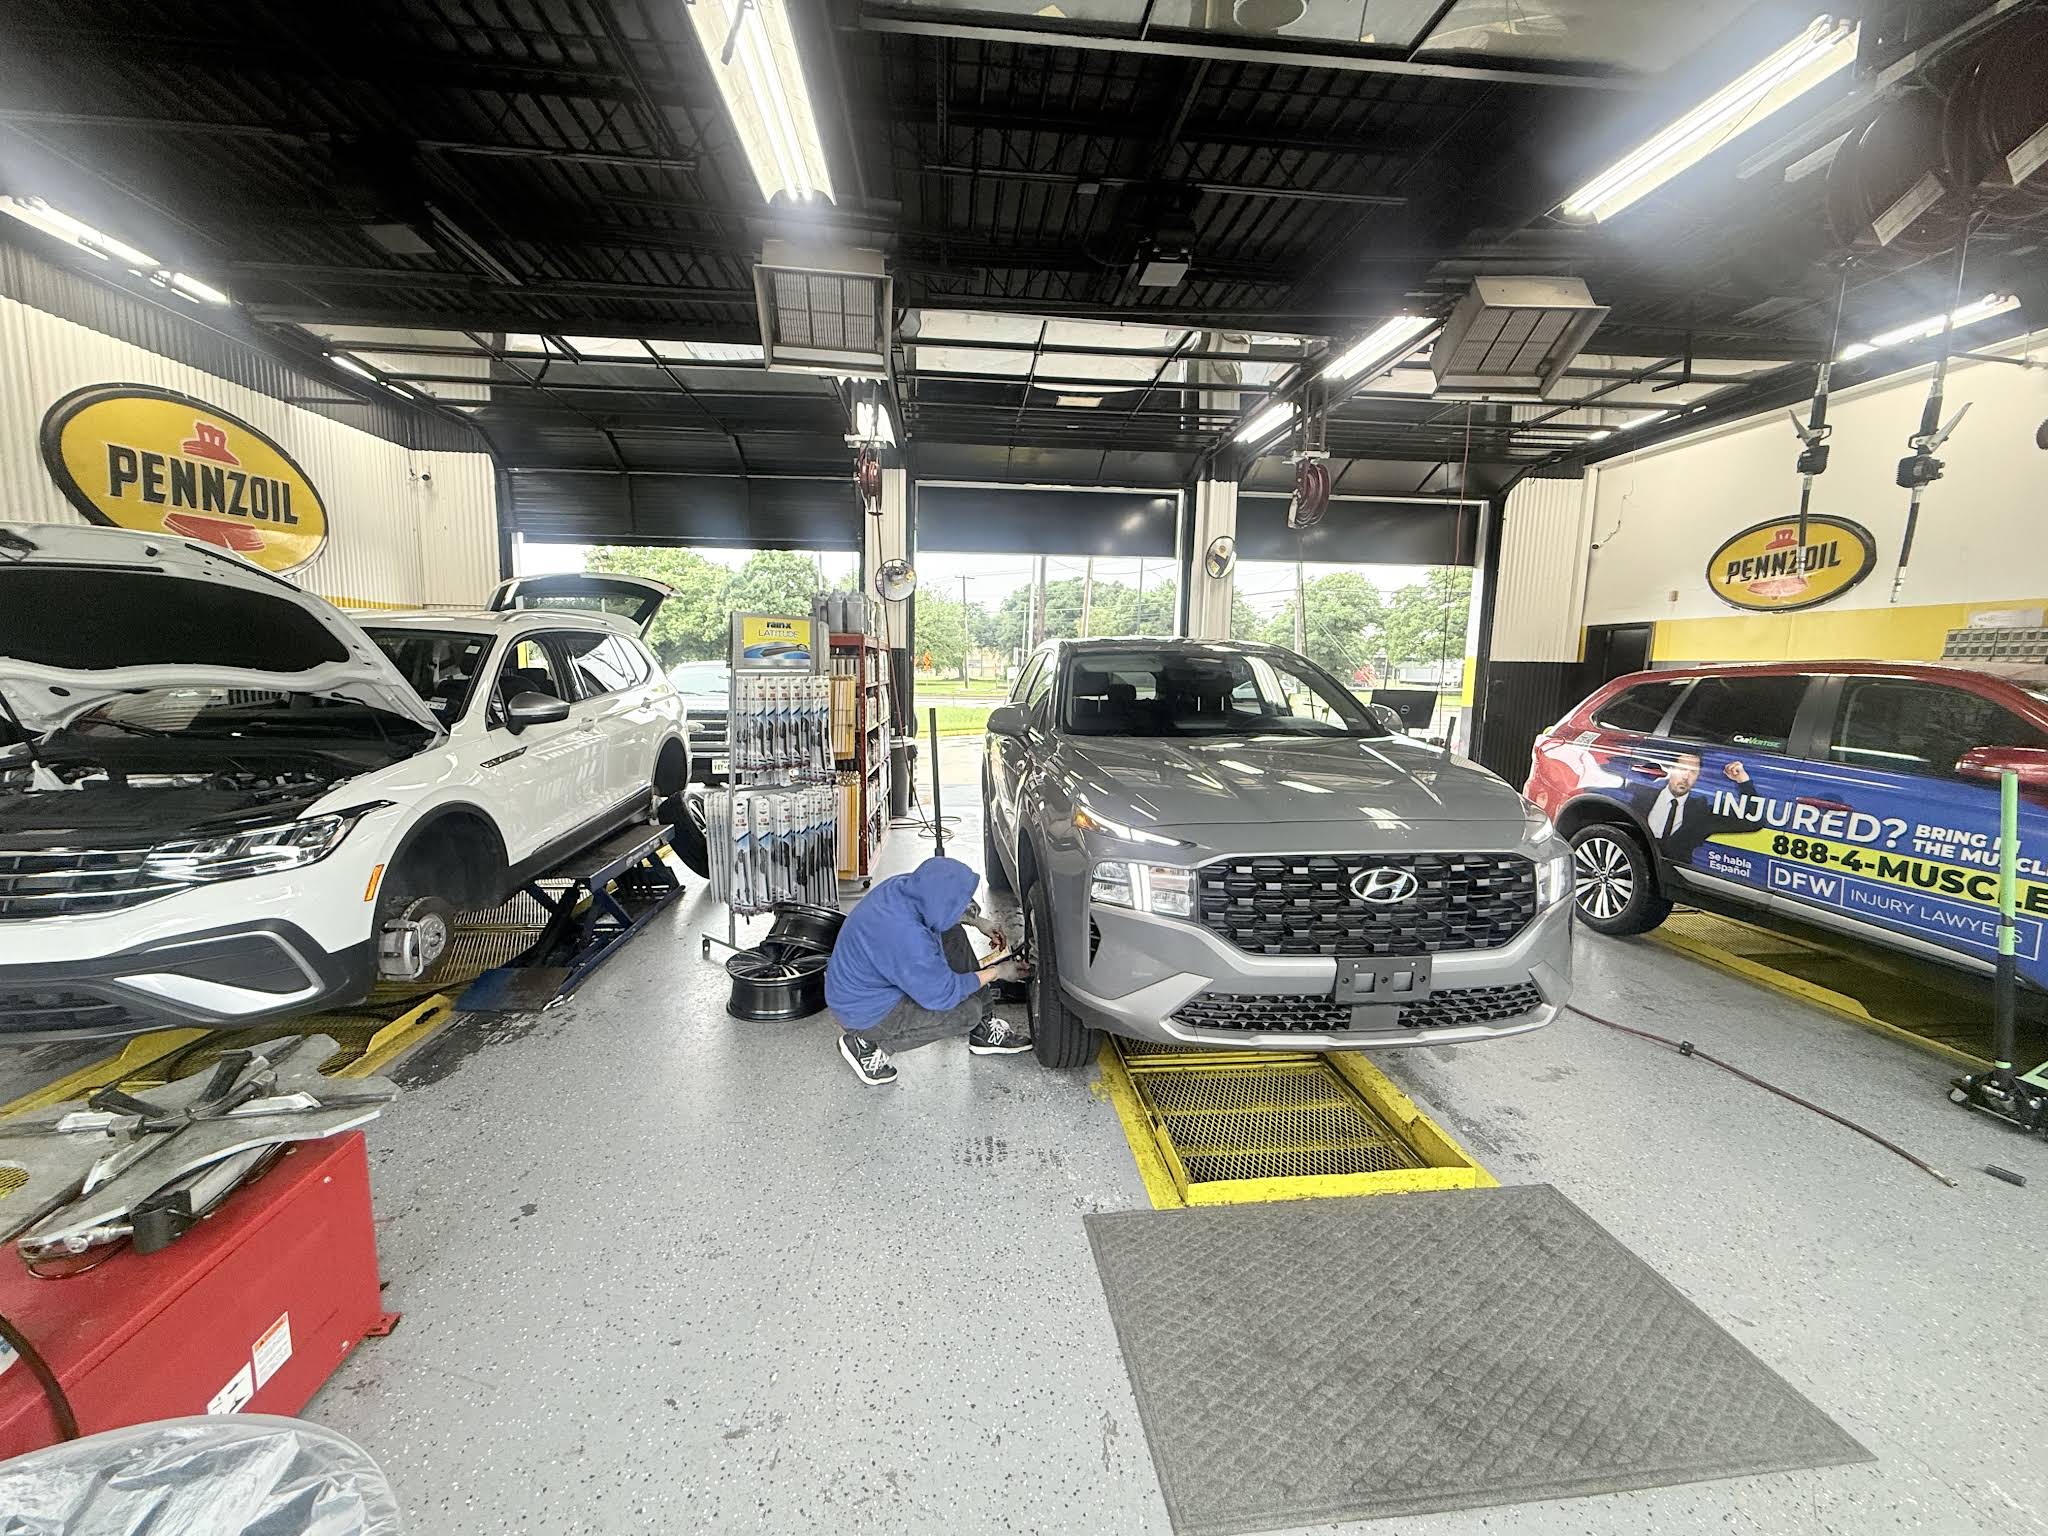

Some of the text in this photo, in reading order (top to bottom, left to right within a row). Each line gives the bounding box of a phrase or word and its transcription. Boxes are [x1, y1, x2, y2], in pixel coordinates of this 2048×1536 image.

[106, 443, 299, 525] PENNZOIL
[1712, 790, 1908, 848] INJURED?
[1914, 823, 1989, 848] BRING
[1708, 850, 1752, 869] Se habla
[1709, 860, 1750, 878] Español
[1912, 838, 2048, 877] THE MUCL
[1774, 867, 1837, 898] DFW
[1850, 888, 1915, 915] INJURY
